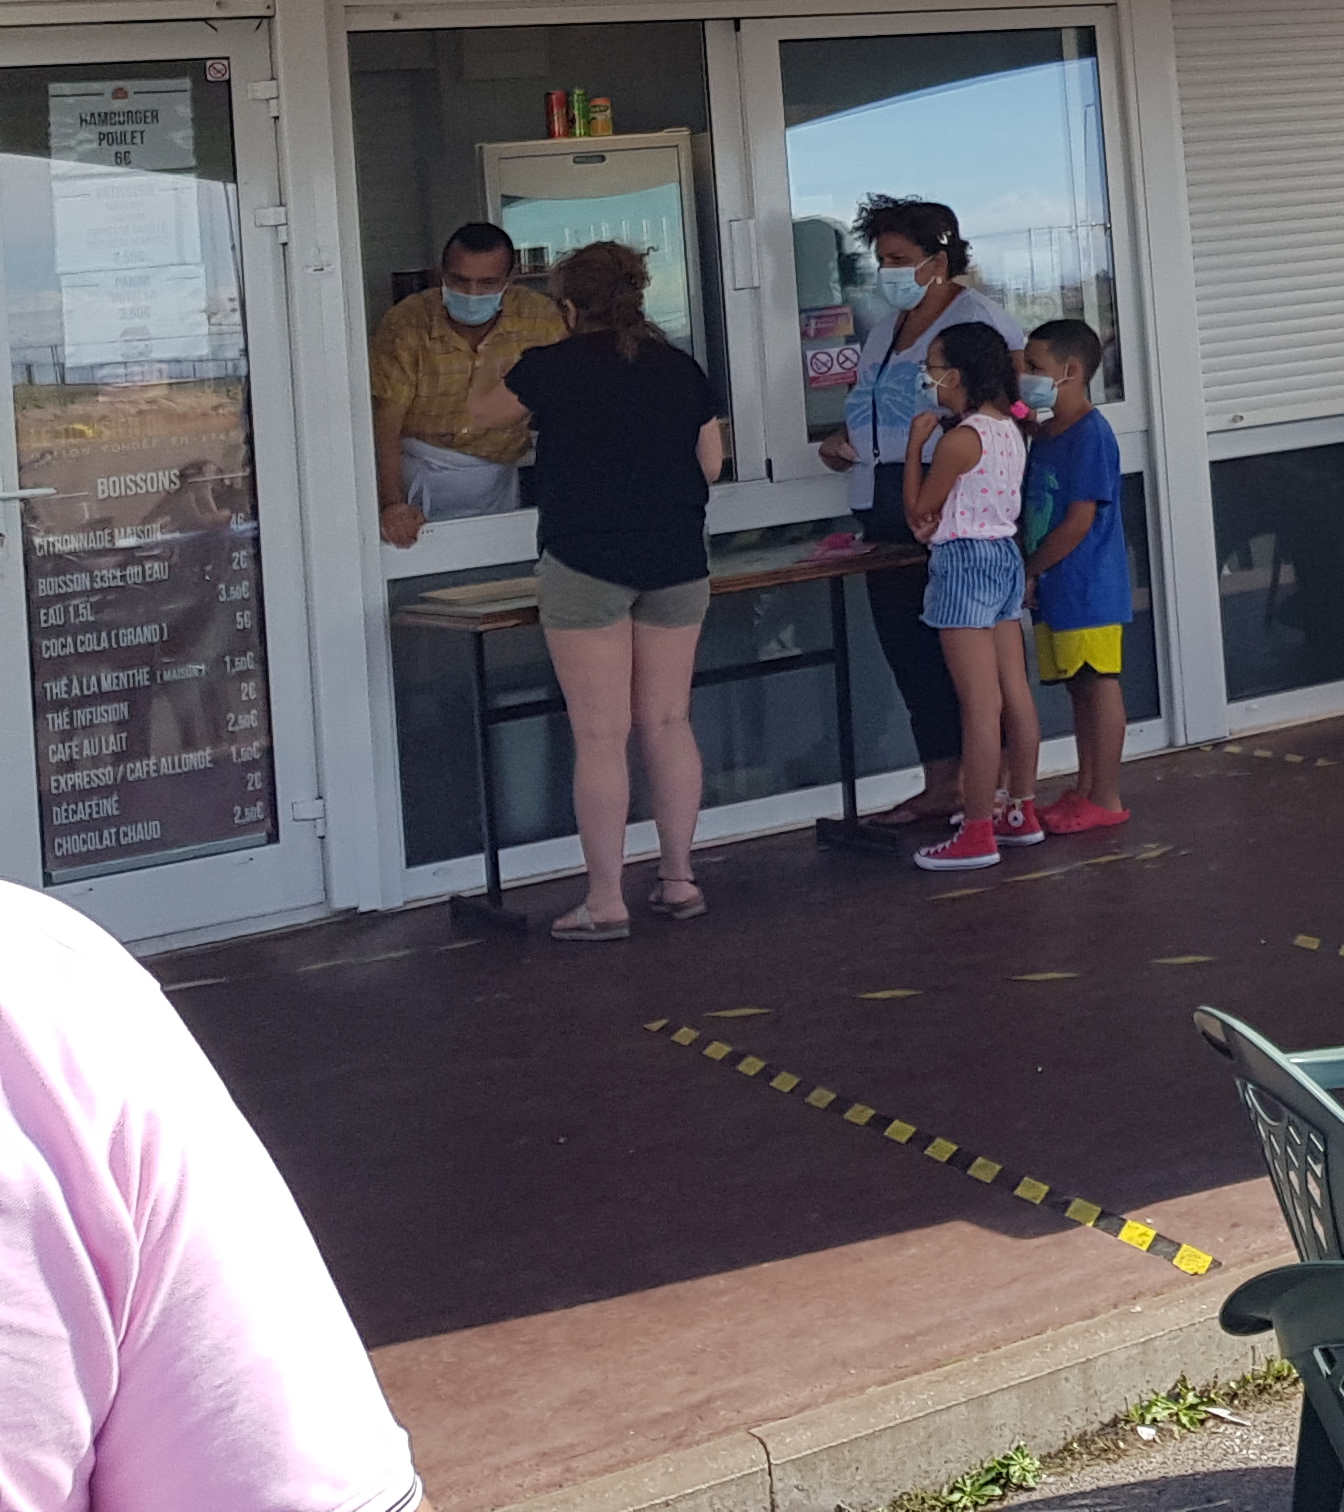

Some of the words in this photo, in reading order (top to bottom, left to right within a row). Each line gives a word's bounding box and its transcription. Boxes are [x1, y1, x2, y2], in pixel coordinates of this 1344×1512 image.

[79, 109, 159, 128] HAMBURGER
[98, 130, 145, 146] POULET
[97, 469, 180, 500] BOISSONS
[38, 572, 90, 597] BOISSON
[145, 561, 169, 581] EAU
[40, 605, 64, 628] EAU
[41, 635, 75, 658] COCA
[77, 632, 108, 653] COLA
[82, 675, 98, 695] LA
[99, 667, 150, 692] MENTHE
[73, 701, 129, 729] INFUSION
[83, 738, 99, 758] AU
[102, 732, 128, 755] LAIT
[51, 768, 113, 795] EXPRESSO
[54, 828, 117, 857] CHOCOLAT
[120, 820, 161, 845] CHAUD
